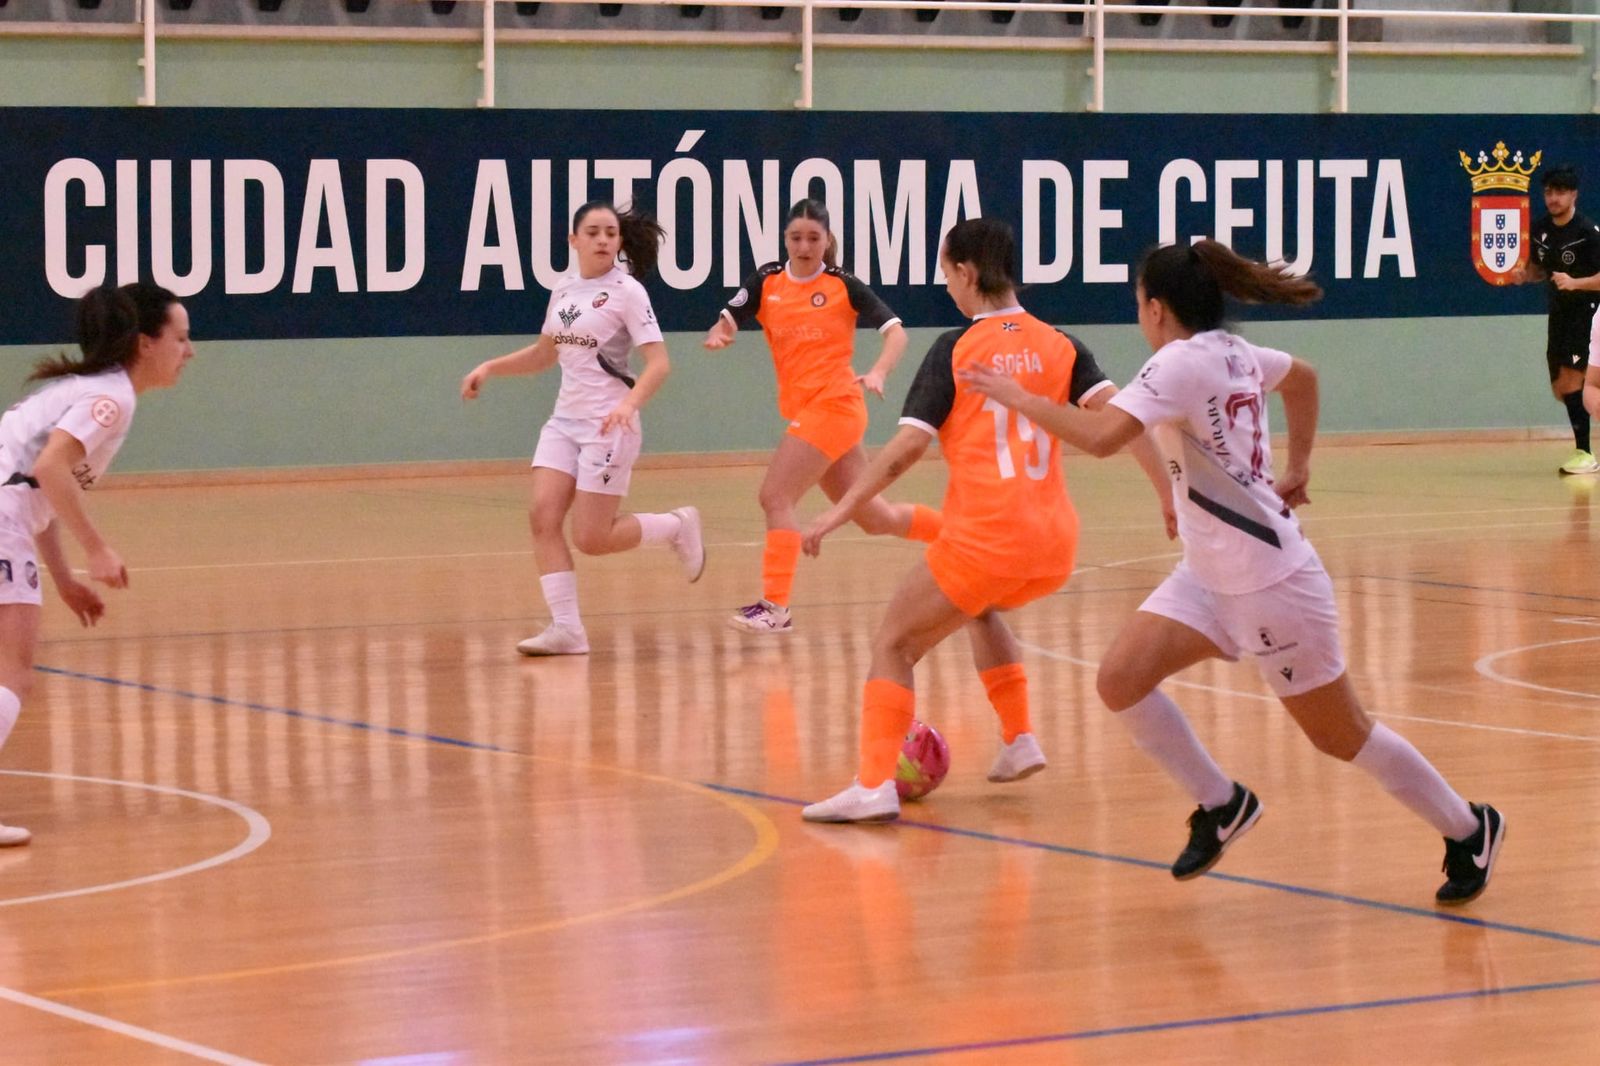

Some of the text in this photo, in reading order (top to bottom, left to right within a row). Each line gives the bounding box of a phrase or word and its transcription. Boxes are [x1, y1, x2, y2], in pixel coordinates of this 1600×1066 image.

[44, 129, 1417, 298] CIUDAD AUTÓNOMA DE CEUTA
[991, 348, 1043, 374] SOFÍA
